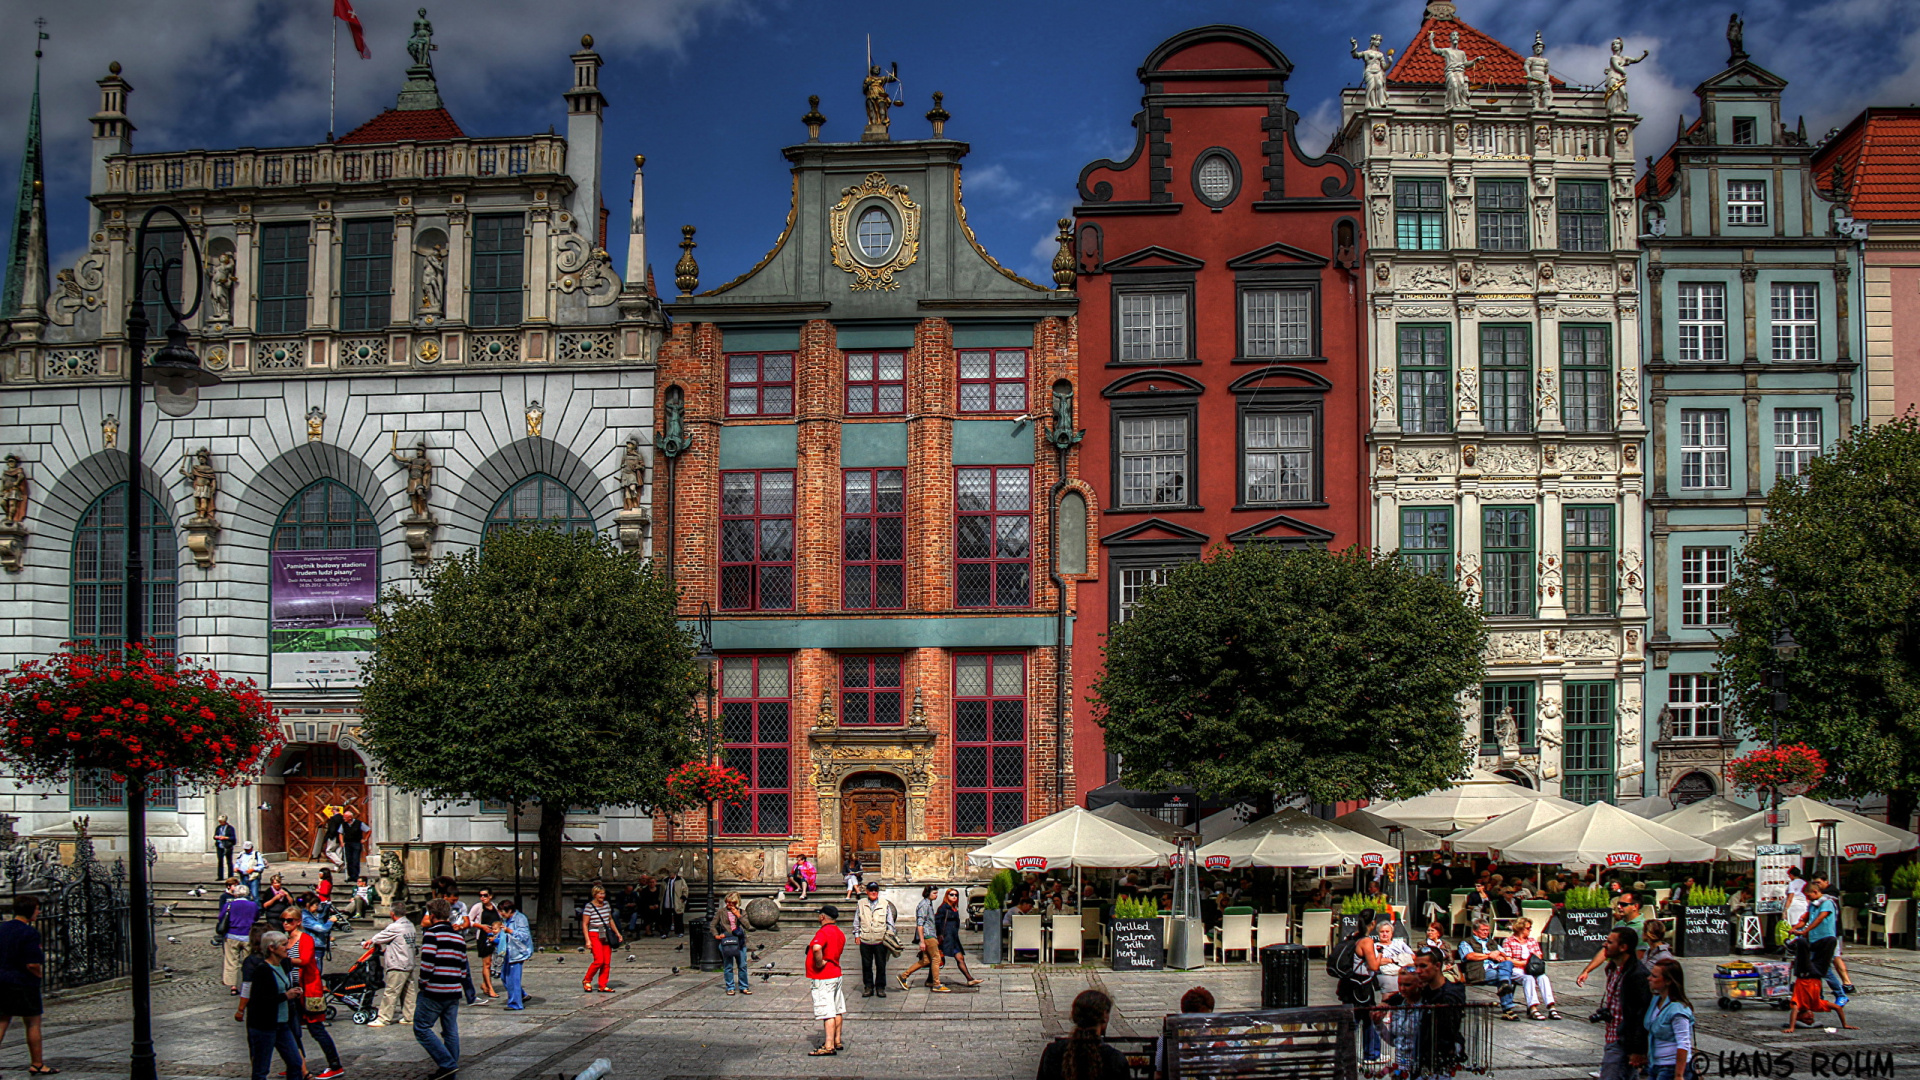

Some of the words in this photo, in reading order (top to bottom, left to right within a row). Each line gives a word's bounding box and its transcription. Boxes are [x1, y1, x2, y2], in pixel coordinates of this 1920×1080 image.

[1566, 911, 1608, 922] cappuccino
[1115, 921, 1150, 931] Grilled
[1116, 932, 1156, 941] salmon
[1125, 940, 1145, 949] with
[1116, 949, 1137, 957] herb
[1131, 954, 1156, 967] butter
